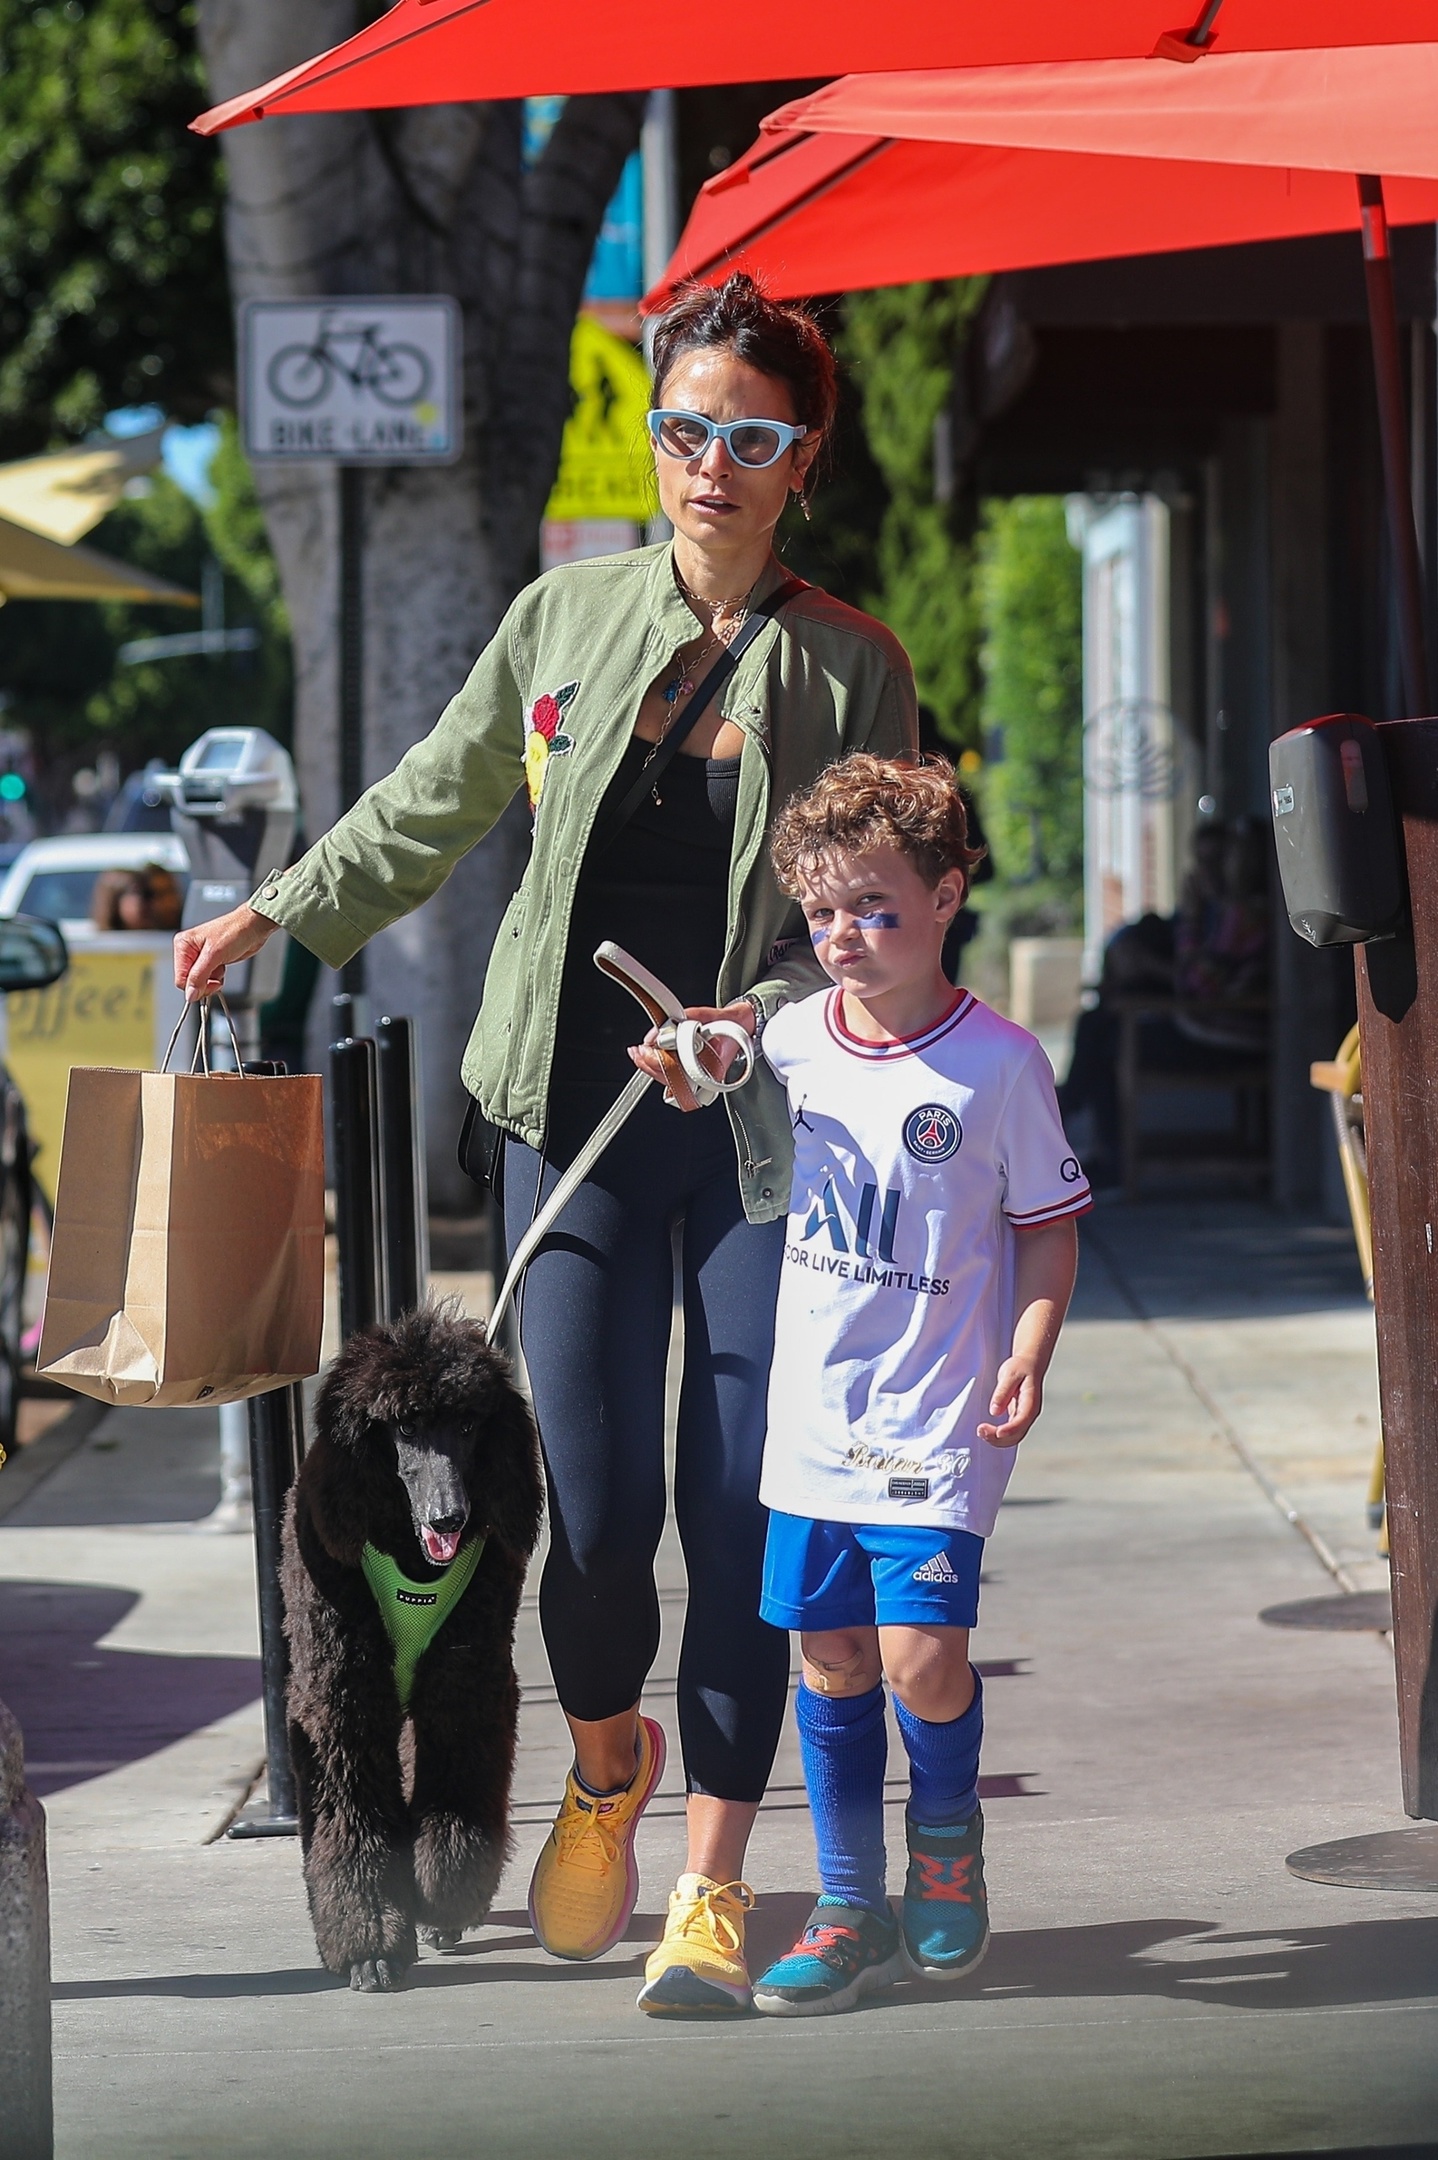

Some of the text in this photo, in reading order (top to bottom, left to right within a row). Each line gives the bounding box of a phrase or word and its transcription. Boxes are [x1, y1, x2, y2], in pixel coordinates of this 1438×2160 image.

[270, 416, 334, 451] BIKE
[919, 1110, 951, 1126] PARIS
[812, 1252, 850, 1279] LIVE
[854, 1264, 950, 1296] LIMITLESS
[912, 1569, 959, 1584] adidas
